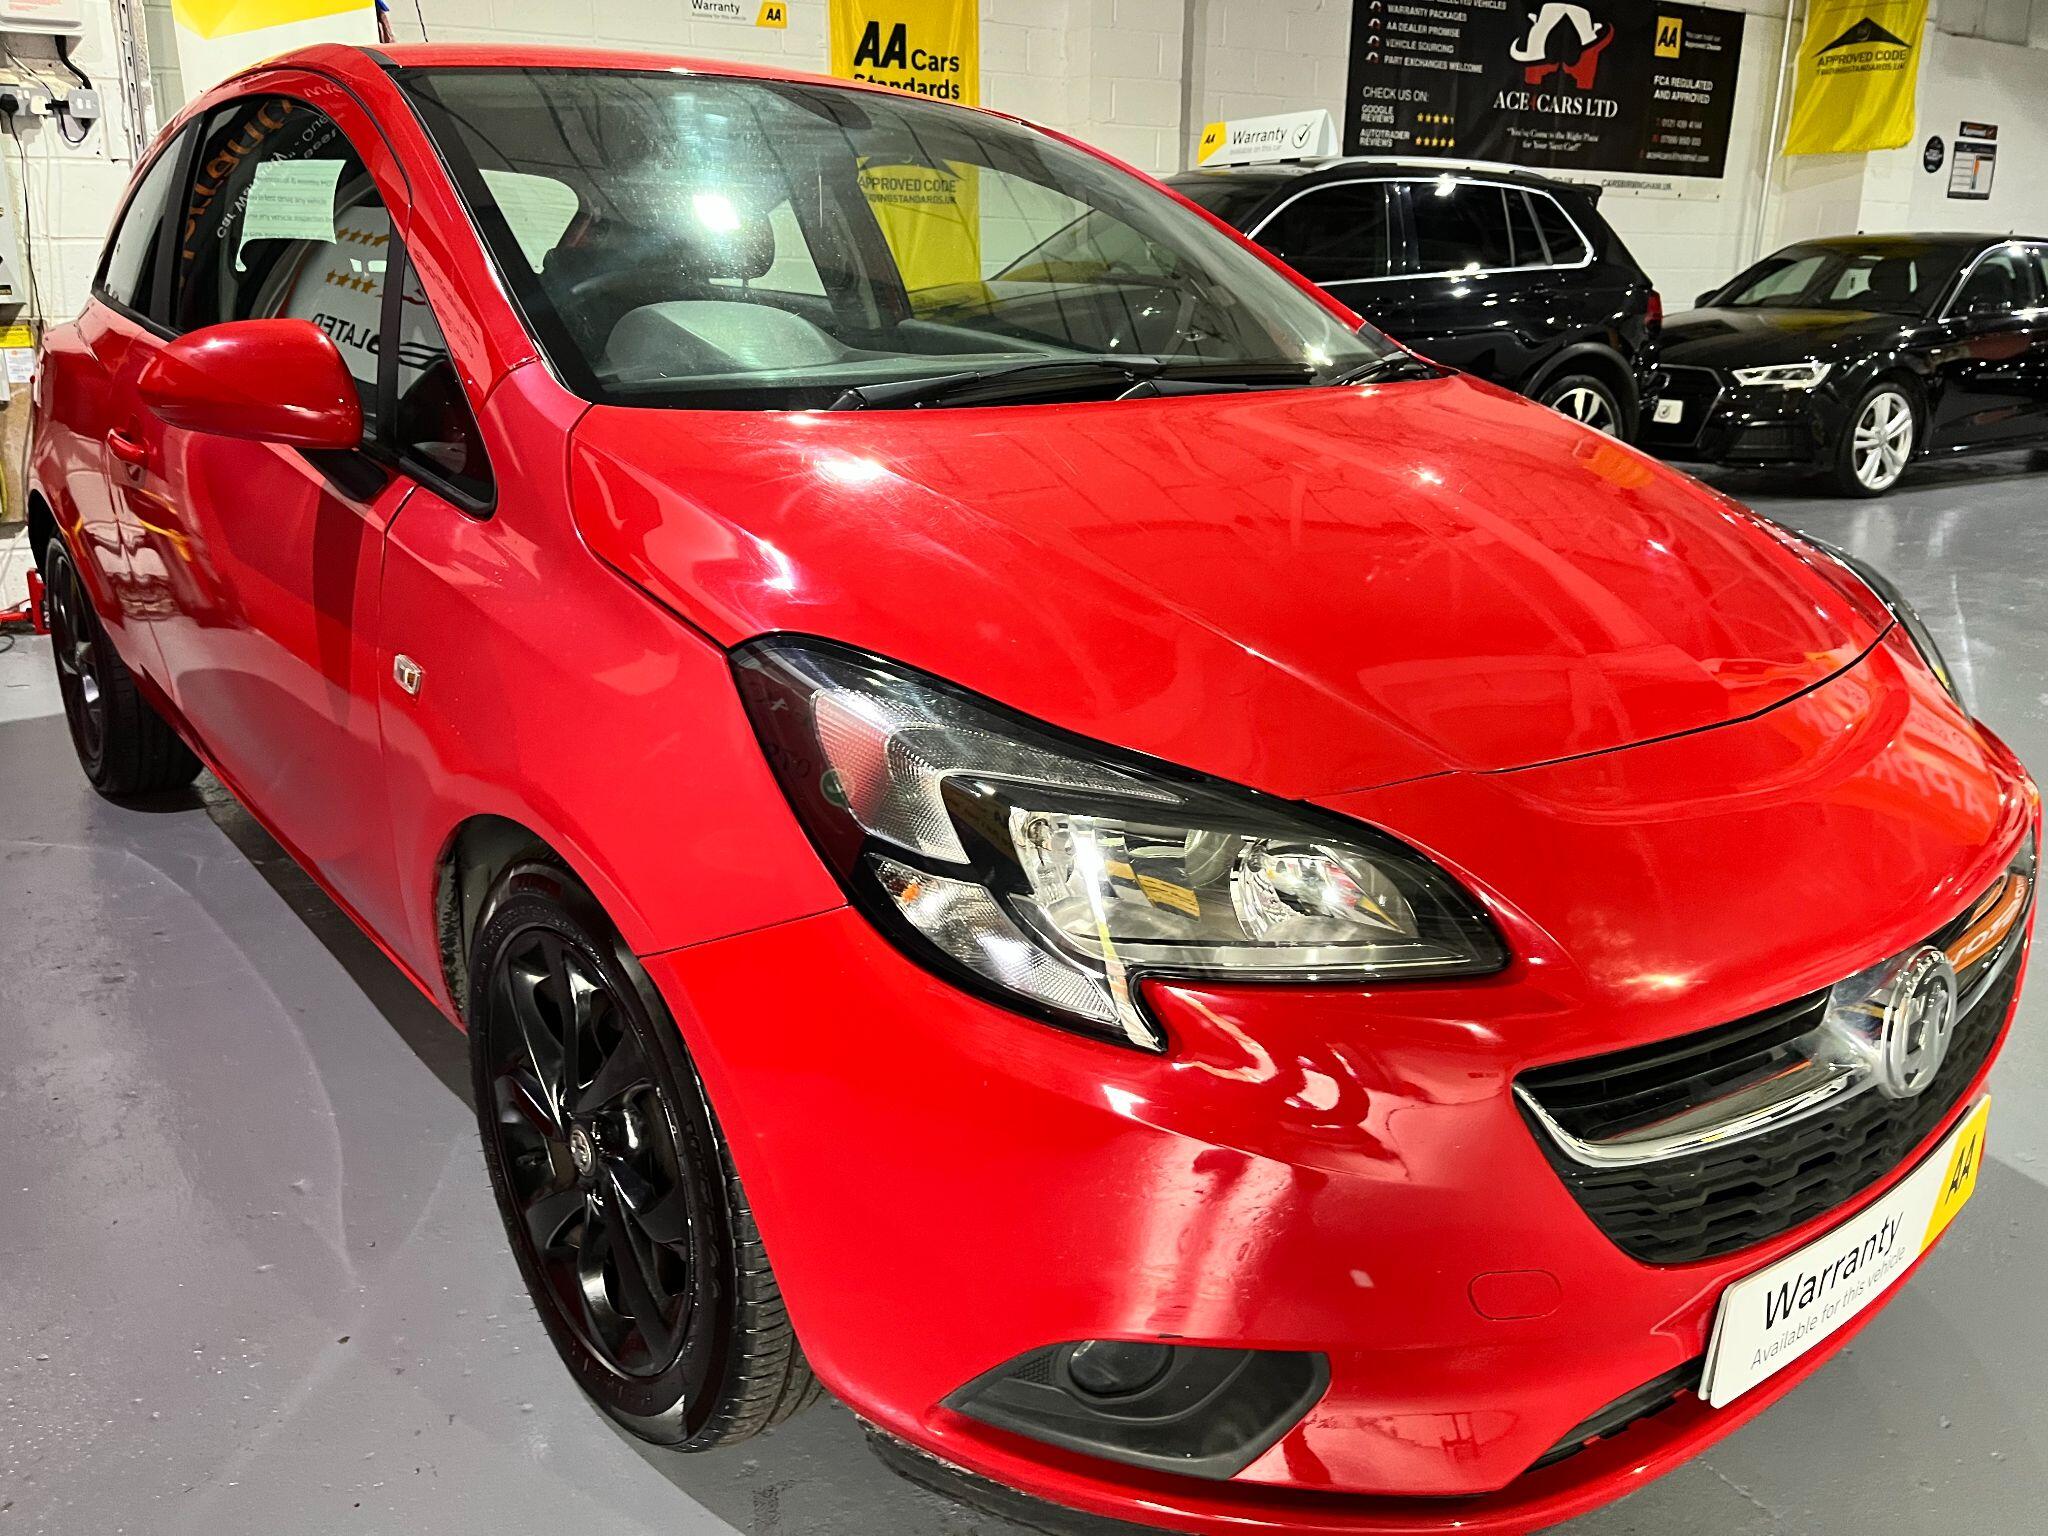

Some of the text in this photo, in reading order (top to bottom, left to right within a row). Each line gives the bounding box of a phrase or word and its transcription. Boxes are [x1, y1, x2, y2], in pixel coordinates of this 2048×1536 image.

[692, 0, 740, 14] Warranty
[766, 8, 781, 21] AA
[1387, 4, 1468, 22] WARRANTY PACKAGES
[1399, 22, 1428, 33] DEALER
[1428, 26, 1461, 38] PROMISE
[1658, 26, 1677, 48] AA
[854, 20, 960, 72] AA Cars
[1386, 38, 1454, 54] VEHICLE SOURCING
[1383, 54, 1483, 74] PART EXCHANGES WELCOME
[1817, 50, 1906, 66] APPROVED CODE
[854, 74, 960, 100] dards
[1654, 75, 1713, 91] FCA REGULATED
[1362, 86, 1396, 100] CHECK
[1398, 89, 1412, 102] US
[1654, 89, 1710, 104] AND APPROVED
[1361, 104, 1394, 114] GOOGLE
[1585, 98, 1618, 118] LTD
[1361, 114, 1394, 124] REVIEWS
[1233, 128, 1288, 144] Warranty
[1360, 128, 1410, 140] AUTOTRADER
[1360, 138, 1394, 148] REVIEWS
[860, 176, 956, 192] APPROVED CODE
[1944, 1132, 1978, 1206] AA
[1765, 1211, 1904, 1330] Warranty
[1750, 1245, 1906, 1370] Available for this vehicle
